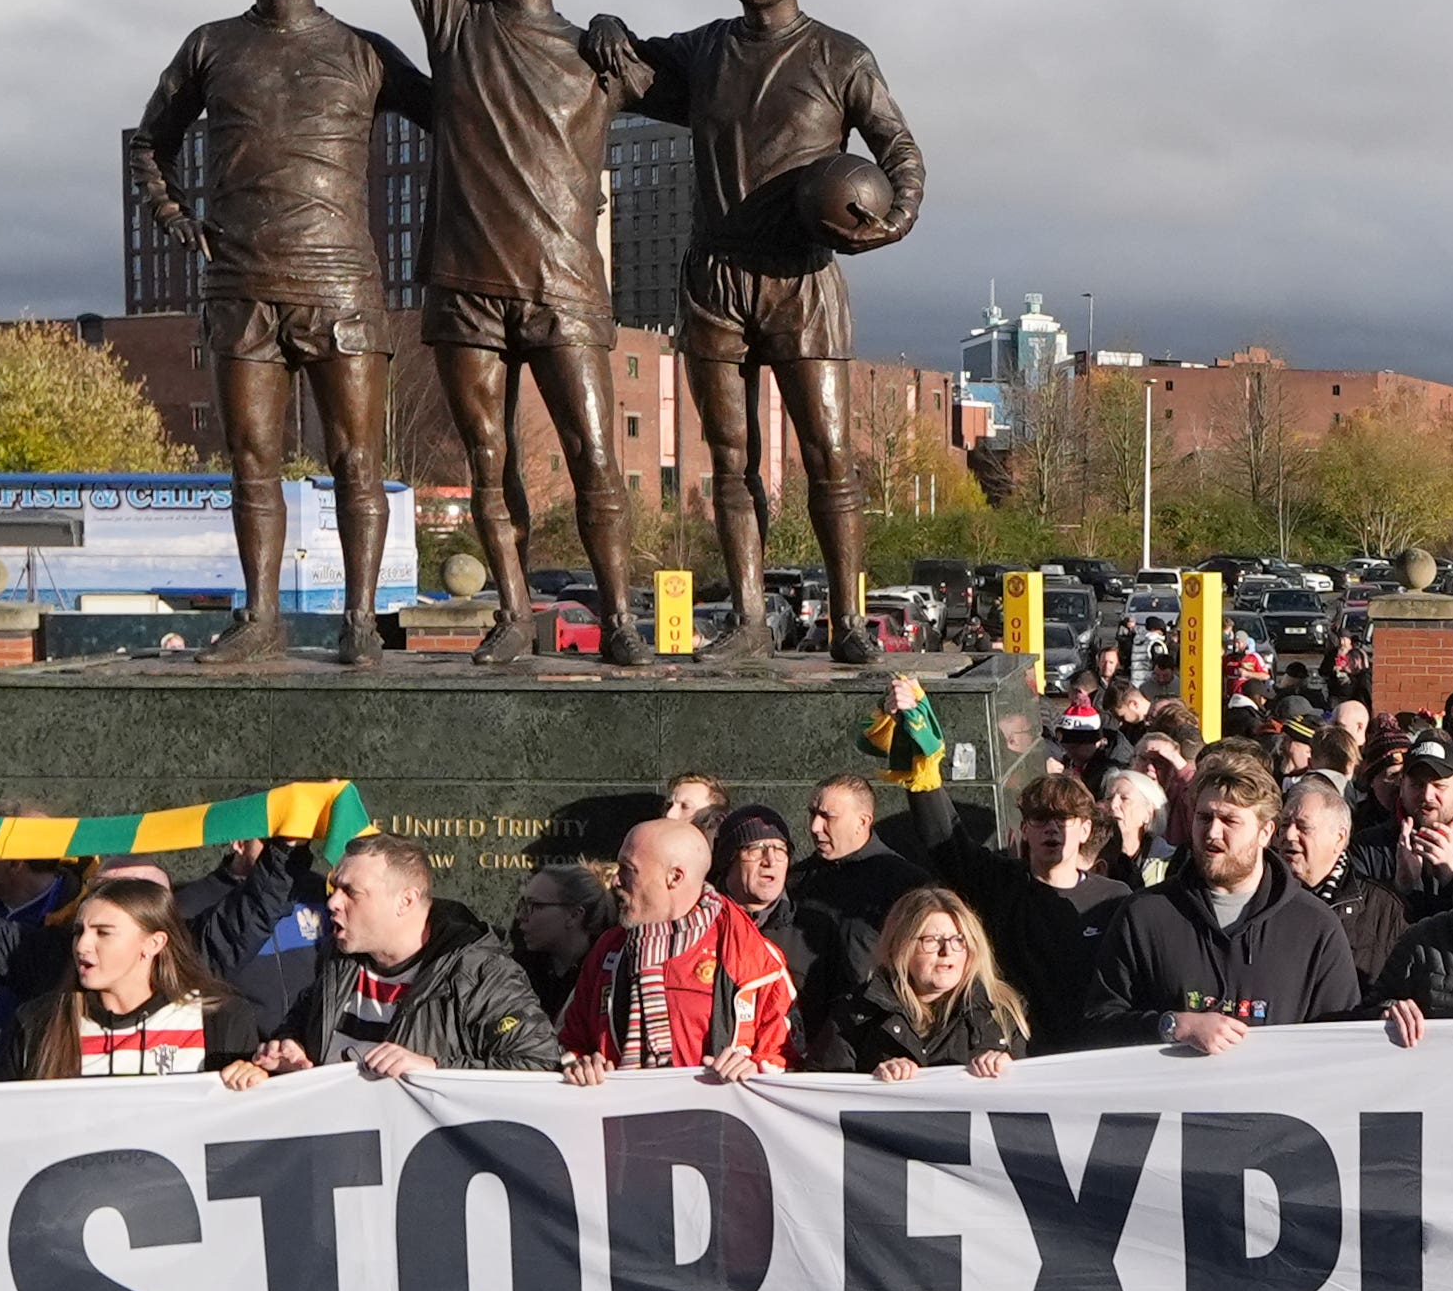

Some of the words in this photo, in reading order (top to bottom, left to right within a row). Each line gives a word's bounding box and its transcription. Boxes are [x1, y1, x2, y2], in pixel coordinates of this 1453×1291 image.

[89, 482, 121, 510] &
[126, 482, 233, 510] CHIPS
[1187, 616, 1198, 656] OUR
[392, 815, 486, 837] UNITED
[492, 815, 589, 838] TRINITY
